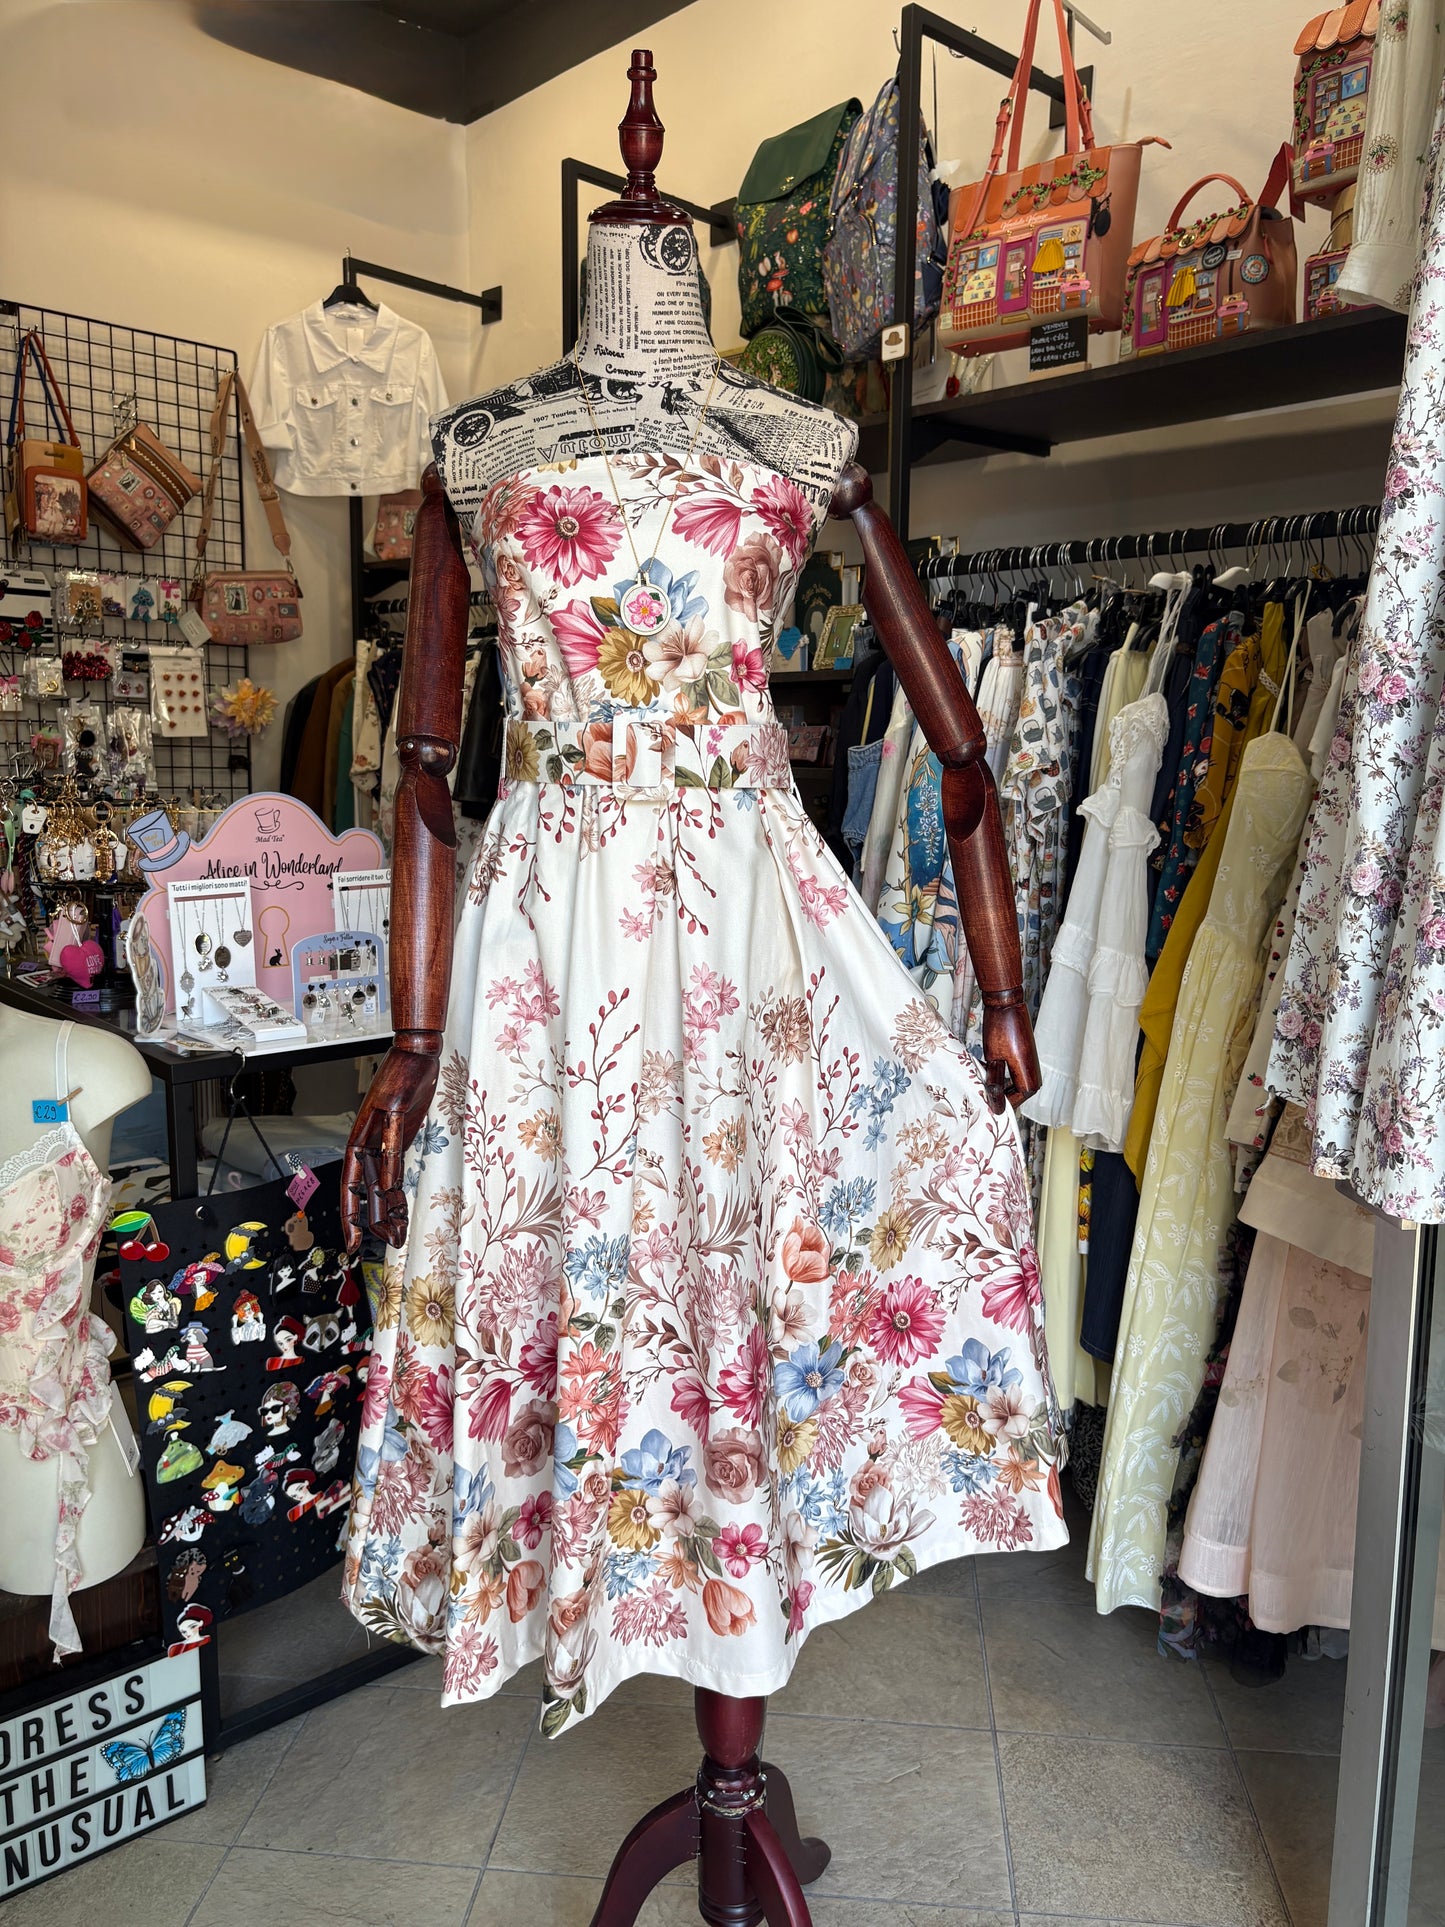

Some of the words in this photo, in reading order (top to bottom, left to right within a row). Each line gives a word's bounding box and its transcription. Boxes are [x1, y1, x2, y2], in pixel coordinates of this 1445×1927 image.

[605, 363, 646, 378] Company
[533, 415, 549, 423] 1907
[551, 409, 577, 419] Touring
[200, 859, 241, 880] Alice
[244, 861, 258, 878] in
[261, 850, 343, 879] Wonderland
[346, 874, 371, 882] sorridere
[171, 884, 188, 892] Tutti
[191, 882, 214, 892] migliori
[34, 1105, 57, 1120] €29
[0, 1756, 90, 1827] THE
[4, 1773, 185, 1886] NUSUAL
